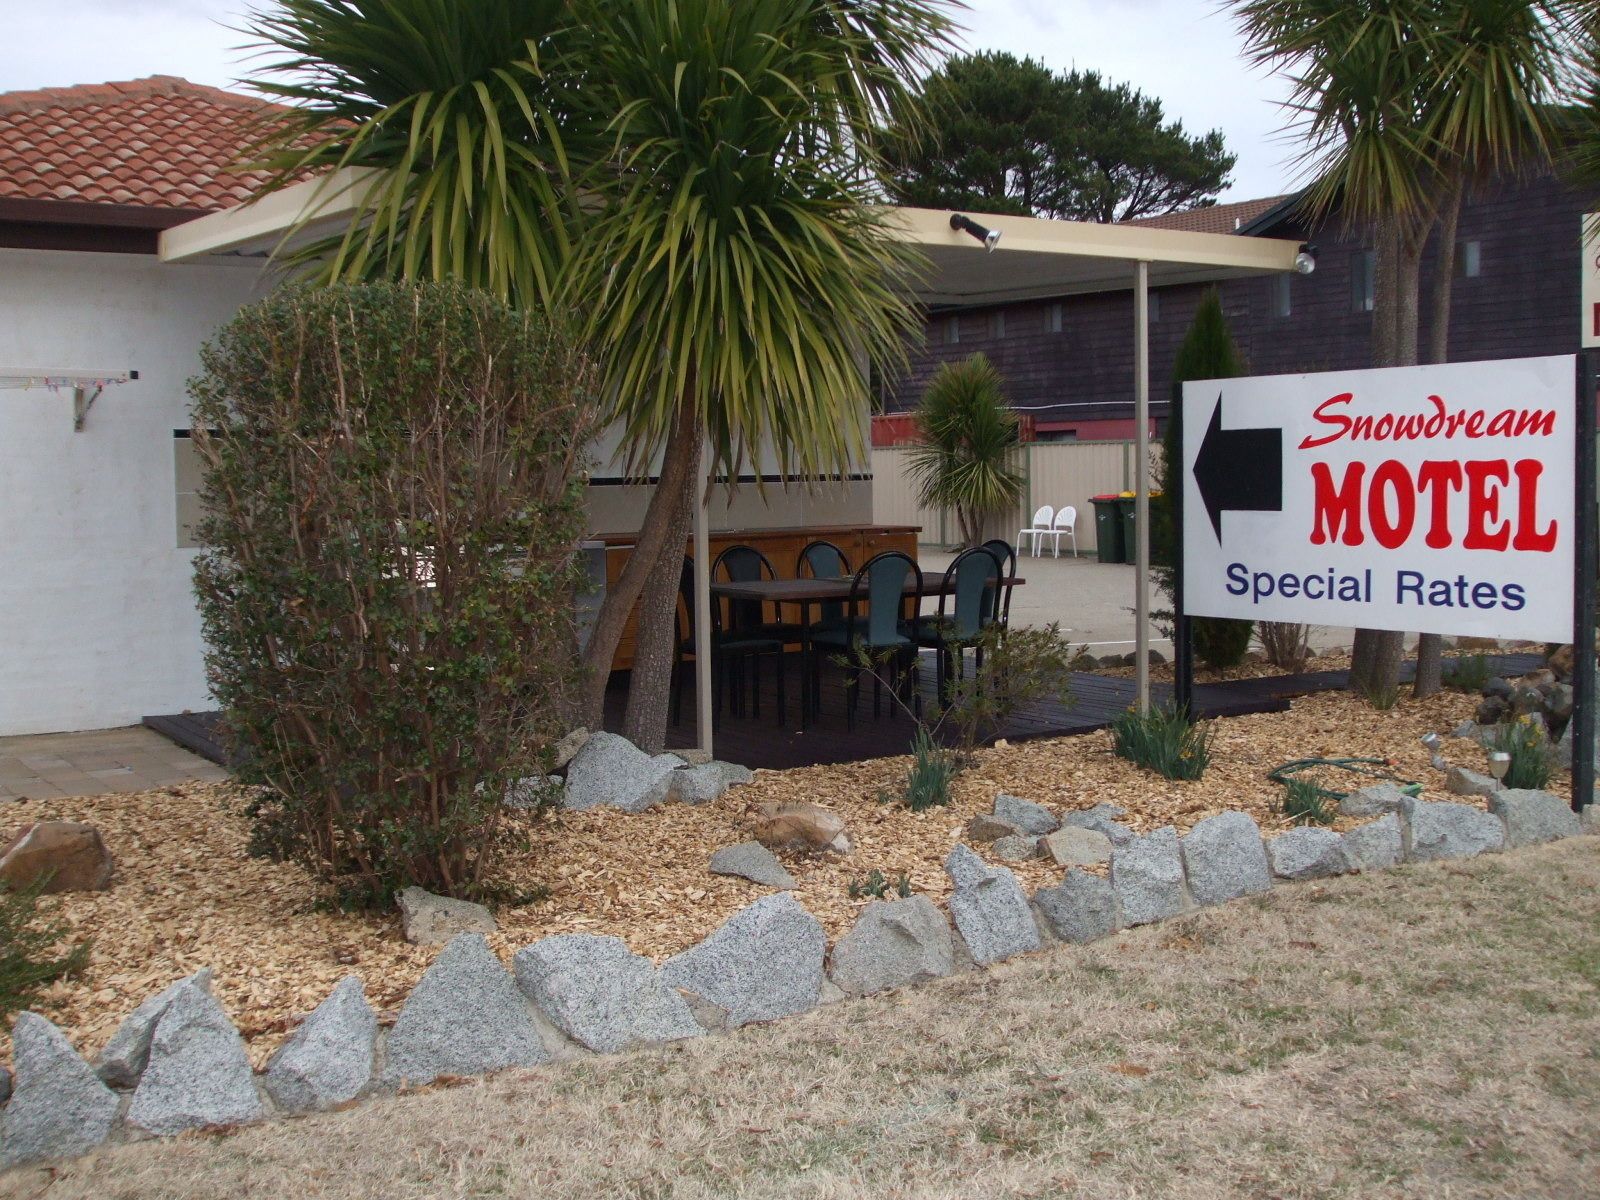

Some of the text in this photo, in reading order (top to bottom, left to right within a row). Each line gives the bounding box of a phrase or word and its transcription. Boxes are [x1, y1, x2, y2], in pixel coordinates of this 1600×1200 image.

[1298, 392, 1557, 450] Snowdream
[1310, 458, 1559, 553] MOTEL
[1225, 562, 1527, 612] Special Rates
